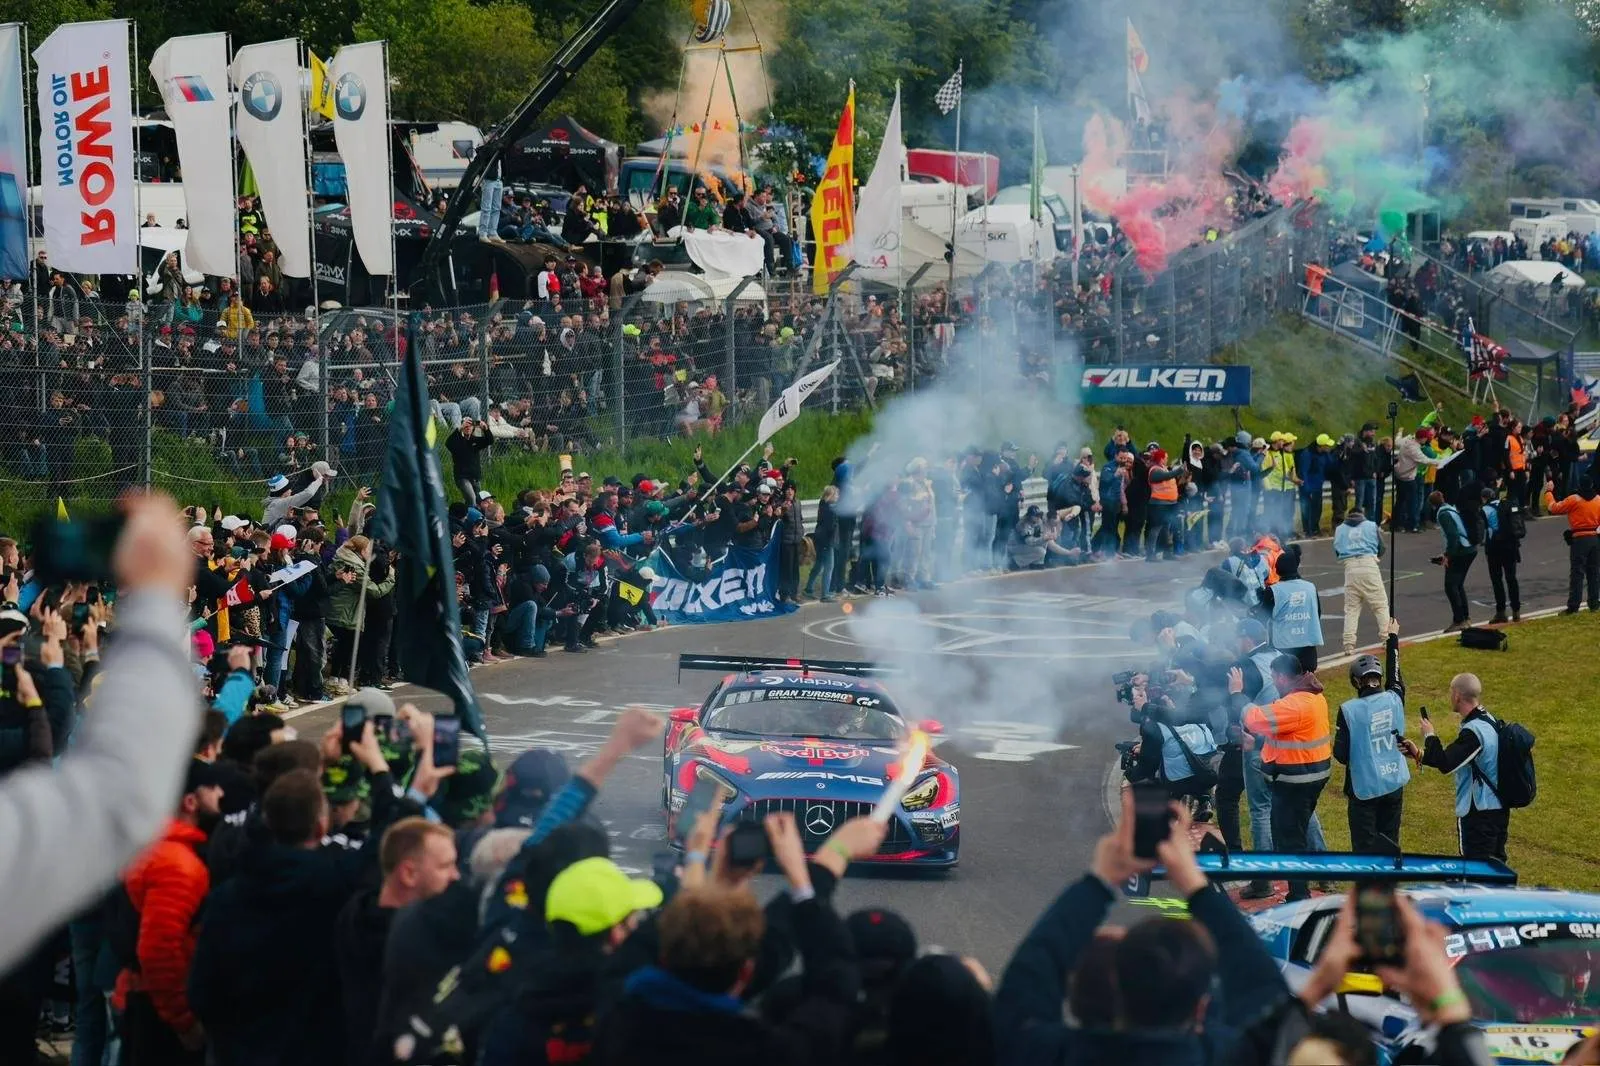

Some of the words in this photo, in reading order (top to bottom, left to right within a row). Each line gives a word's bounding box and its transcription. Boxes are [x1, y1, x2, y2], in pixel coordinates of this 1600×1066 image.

[1081, 368, 1227, 388] FALKEN
[1185, 391, 1223, 402] TYRES
[1284, 611, 1311, 621] MEDIA
[788, 677, 854, 689] viaplay
[768, 689, 798, 697] GRAN
[800, 689, 848, 700] TURISMO
[1372, 734, 1395, 754] TV
[760, 744, 815, 759] Red
[817, 748, 870, 760] Bull
[1380, 762, 1399, 776] 362
[797, 772, 884, 786] AMG
[1444, 925, 1521, 957] 24H
